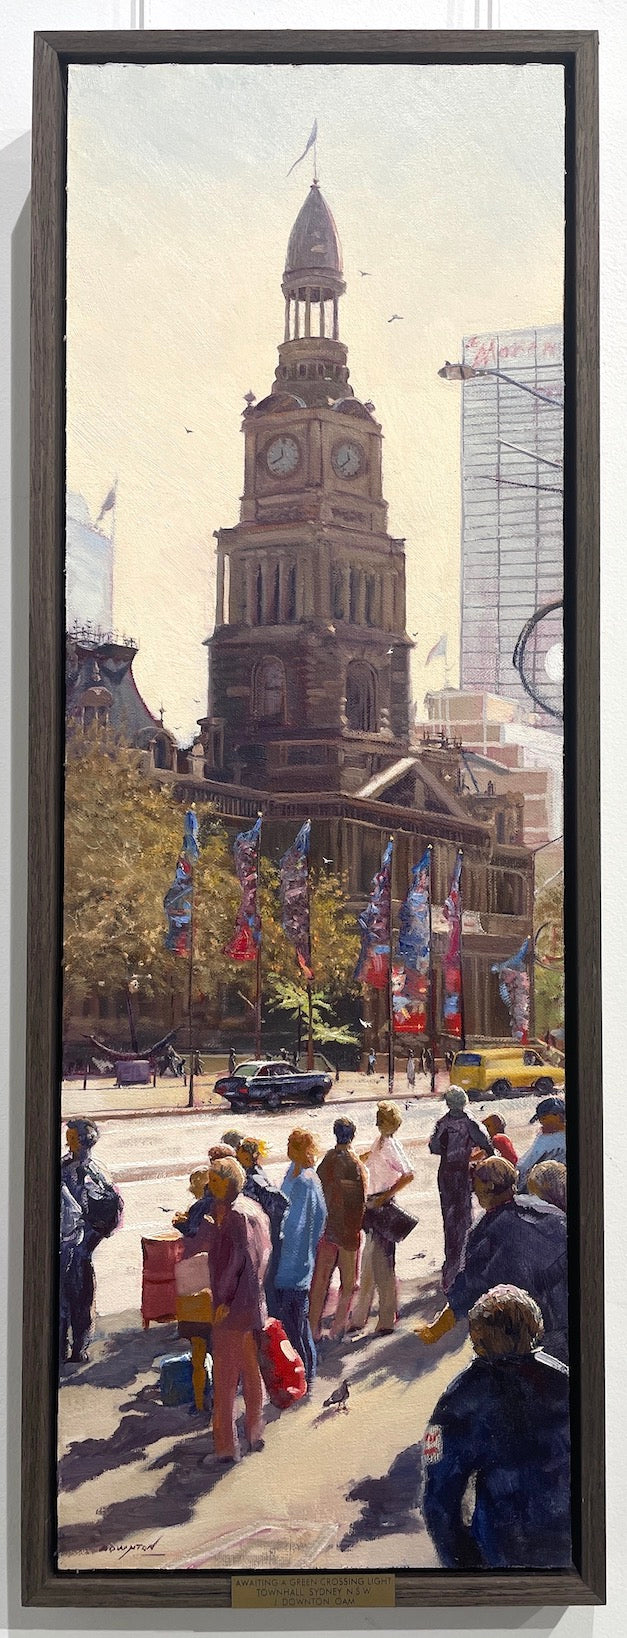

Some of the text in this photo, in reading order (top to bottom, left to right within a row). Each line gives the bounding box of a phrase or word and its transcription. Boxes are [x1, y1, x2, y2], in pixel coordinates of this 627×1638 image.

[289, 1578, 318, 1587] GREEN
[320, 1577, 365, 1586] CROSSING
[368, 1577, 392, 1585] LIGHT
[256, 1588, 304, 1597] TOWNHALL
[309, 1587, 342, 1597] SYDNEY
[282, 1597, 330, 1606] DOWNTON
[334, 1597, 355, 1605] OAM
